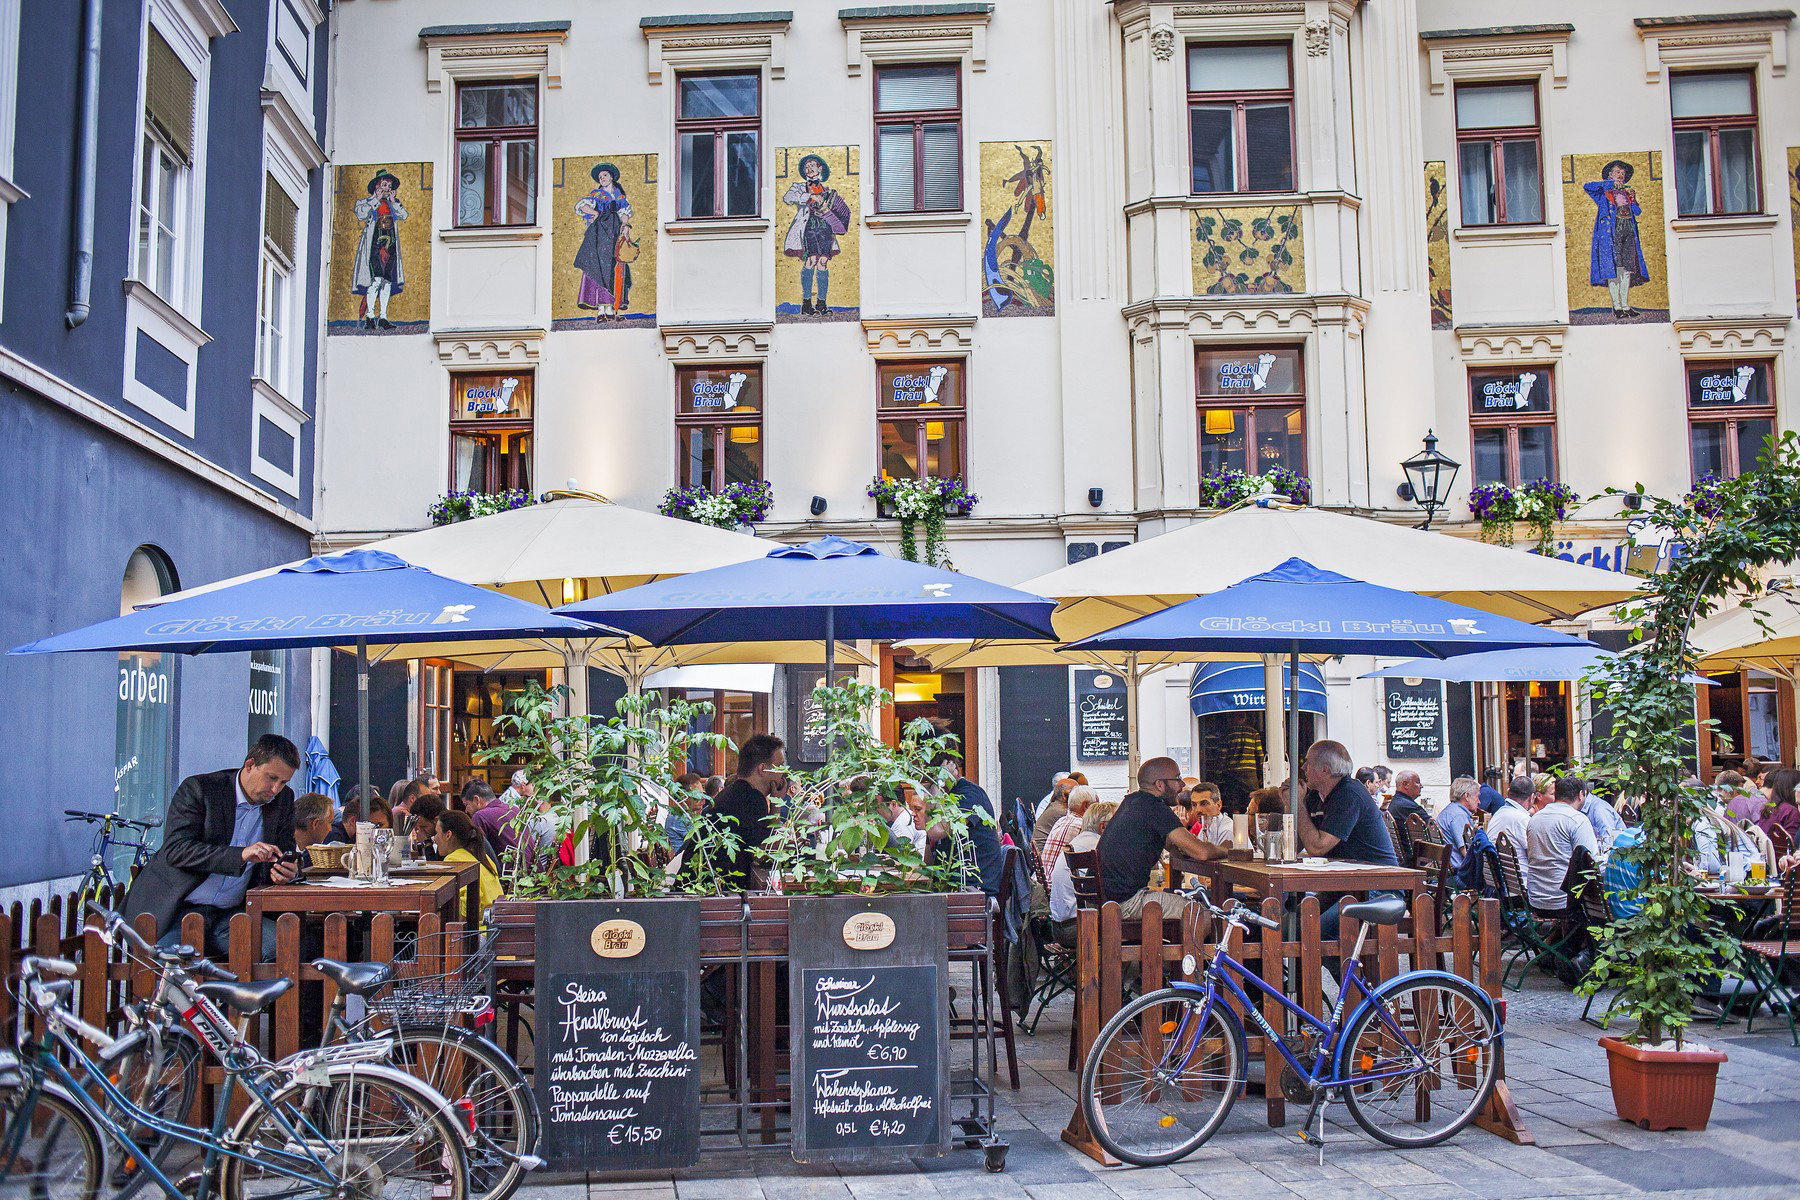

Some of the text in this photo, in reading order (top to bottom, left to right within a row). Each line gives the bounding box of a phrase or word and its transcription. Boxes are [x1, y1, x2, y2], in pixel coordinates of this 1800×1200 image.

[1221, 361, 1258, 375] Glöckl
[693, 381, 730, 394] Glöckl
[893, 374, 930, 388] Glöckl
[1222, 375, 1251, 388] Bräu
[1484, 381, 1520, 394] Glöckl
[1701, 374, 1737, 388] Glöckl
[466, 386, 500, 399] Glöckl
[894, 388, 922, 401] Bräu
[1702, 388, 1731, 401] Bräu
[467, 399, 494, 412] Bräu
[694, 394, 722, 407] Bräu
[1485, 394, 1514, 407] Bräu
[1527, 539, 1623, 572] öckl
[145, 609, 430, 636] Glöckl Bräu
[1200, 616, 1446, 634] Glöckl Bräu
[603, 928, 633, 940] Glöckl
[814, 990, 901, 1021] Wurstsalat
[813, 1021, 829, 1034] mit
[812, 1034, 832, 1049] und
[552, 1048, 574, 1063] mit
[613, 1063, 635, 1079] mit
[548, 1081, 651, 1109] Pappardelle auf
[550, 1104, 639, 1123] Tomatensauce
